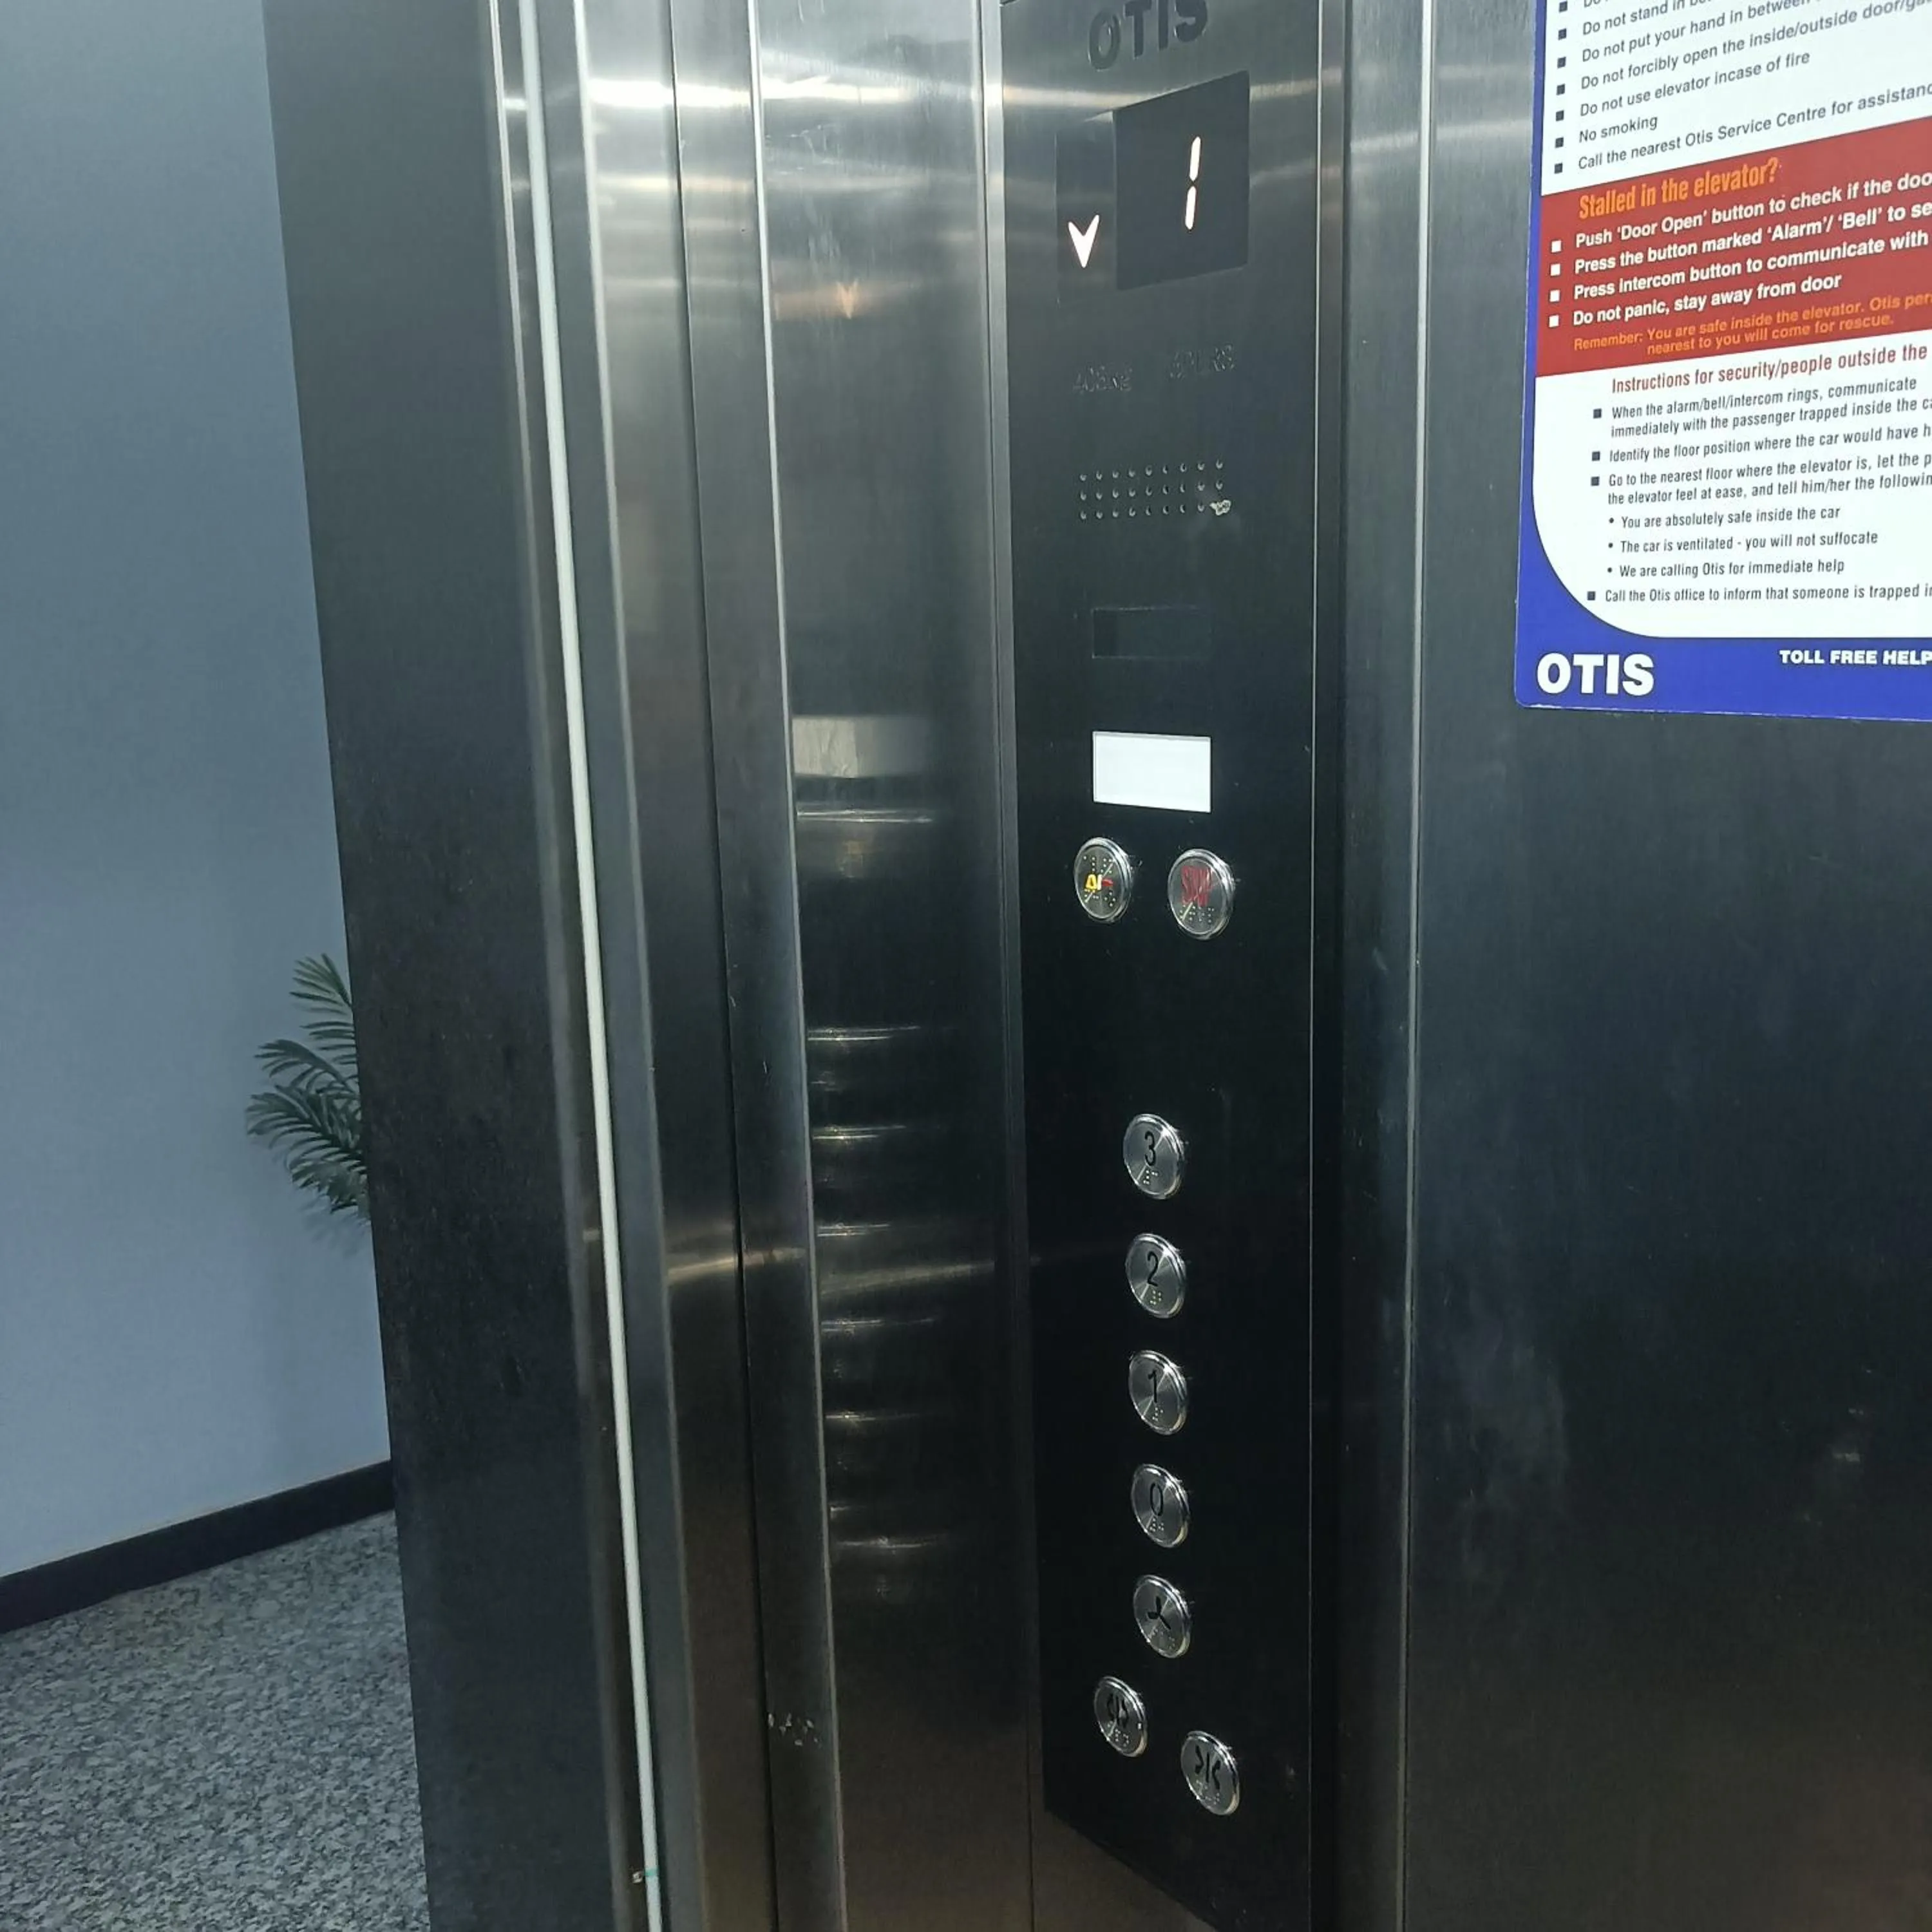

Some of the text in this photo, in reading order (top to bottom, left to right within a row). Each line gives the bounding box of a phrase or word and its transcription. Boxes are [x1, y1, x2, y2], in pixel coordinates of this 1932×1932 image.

[1088, 0, 1208, 71] OTIS
[1582, 21, 1601, 36] Do
[1604, 13, 1626, 30] not
[1630, 3, 1669, 23] stand
[1582, 10, 1743, 63] Do not put your hand in
[1581, 75, 1599, 90] Do
[1602, 68, 1624, 84] not
[1628, 55, 1679, 79] forcibly
[1683, 46, 1718, 66] open
[1723, 39, 1745, 55] the
[1580, 52, 1810, 117] Do not use elevator incase of fire
[1578, 100, 1853, 170] Call the nearest Otis Service Centre for
[1579, 116, 1658, 143] No smoking
[1184, 136, 1202, 231] 1
[1579, 187, 1636, 220] Stalled
[1640, 185, 1656, 207] in
[1661, 180, 1689, 204] the
[1576, 228, 1613, 249] Push
[1711, 202, 1765, 224] button
[1768, 198, 1786, 214] to
[1790, 187, 1842, 211] check
[1847, 183, 1859, 200] if
[1863, 179, 1893, 197] the
[1575, 256, 1616, 274] Press
[1620, 251, 1644, 267] the
[1647, 242, 1698, 263] button
[1702, 227, 1763, 253] marked
[1887, 206, 1906, 223] to
[1574, 282, 1615, 299] Press
[1689, 262, 1742, 282] button
[1746, 258, 1763, 273] to
[1766, 238, 1885, 270] communicate
[1889, 231, 1929, 251] with
[1573, 310, 1594, 326] Do
[1596, 305, 1622, 323] not
[1674, 294, 1707, 312] stay
[1710, 288, 1753, 307] away
[1757, 281, 1796, 299] from
[1801, 274, 1842, 293] door
[1612, 372, 1690, 393] Instructions
[1694, 368, 1714, 385] for
[1838, 346, 1897, 370] outside
[1902, 343, 1927, 362] the
[1611, 398, 1917, 437] immediately with the passenger trapped inside the
[1612, 406, 1642, 420] When
[1645, 403, 1663, 416] the
[1828, 377, 1917, 399] communicate
[1609, 426, 1918, 463] Identify the floor position where the car would have
[1609, 474, 1623, 487] Go
[1626, 473, 1636, 486] to
[1640, 472, 1657, 485] the
[1660, 468, 1702, 484] nearest
[1706, 468, 1733, 480] floor
[1736, 465, 1773, 478] where
[1777, 462, 1796, 475] the
[1800, 459, 1853, 475] elevator
[1877, 455, 1894, 469] let
[1899, 454, 1919, 468] the
[1608, 492, 1625, 505] the
[1627, 489, 1672, 505] elevator
[1676, 487, 1697, 502] feel
[1701, 486, 1712, 500] at
[1751, 482, 1774, 497] and
[1777, 480, 1797, 496] tell
[1855, 477, 1875, 491] the
[1621, 507, 1841, 529] You are absolutely safe inside the car
[1620, 531, 1878, 553] The car is ventilated you will not suffocate
[1620, 559, 1844, 579] We are calling Otis for immediate help
[1605, 583, 1920, 603] Call the Otis office to inform that someone is trapped
[1537, 652, 1654, 697] OTIS
[1779, 650, 1825, 665] TOLL
[1830, 649, 1878, 665] FREE
[1144, 1130, 1156, 1167] 3
[1146, 1251, 1159, 1287] 2
[1147, 1369, 1158, 1403] 1
